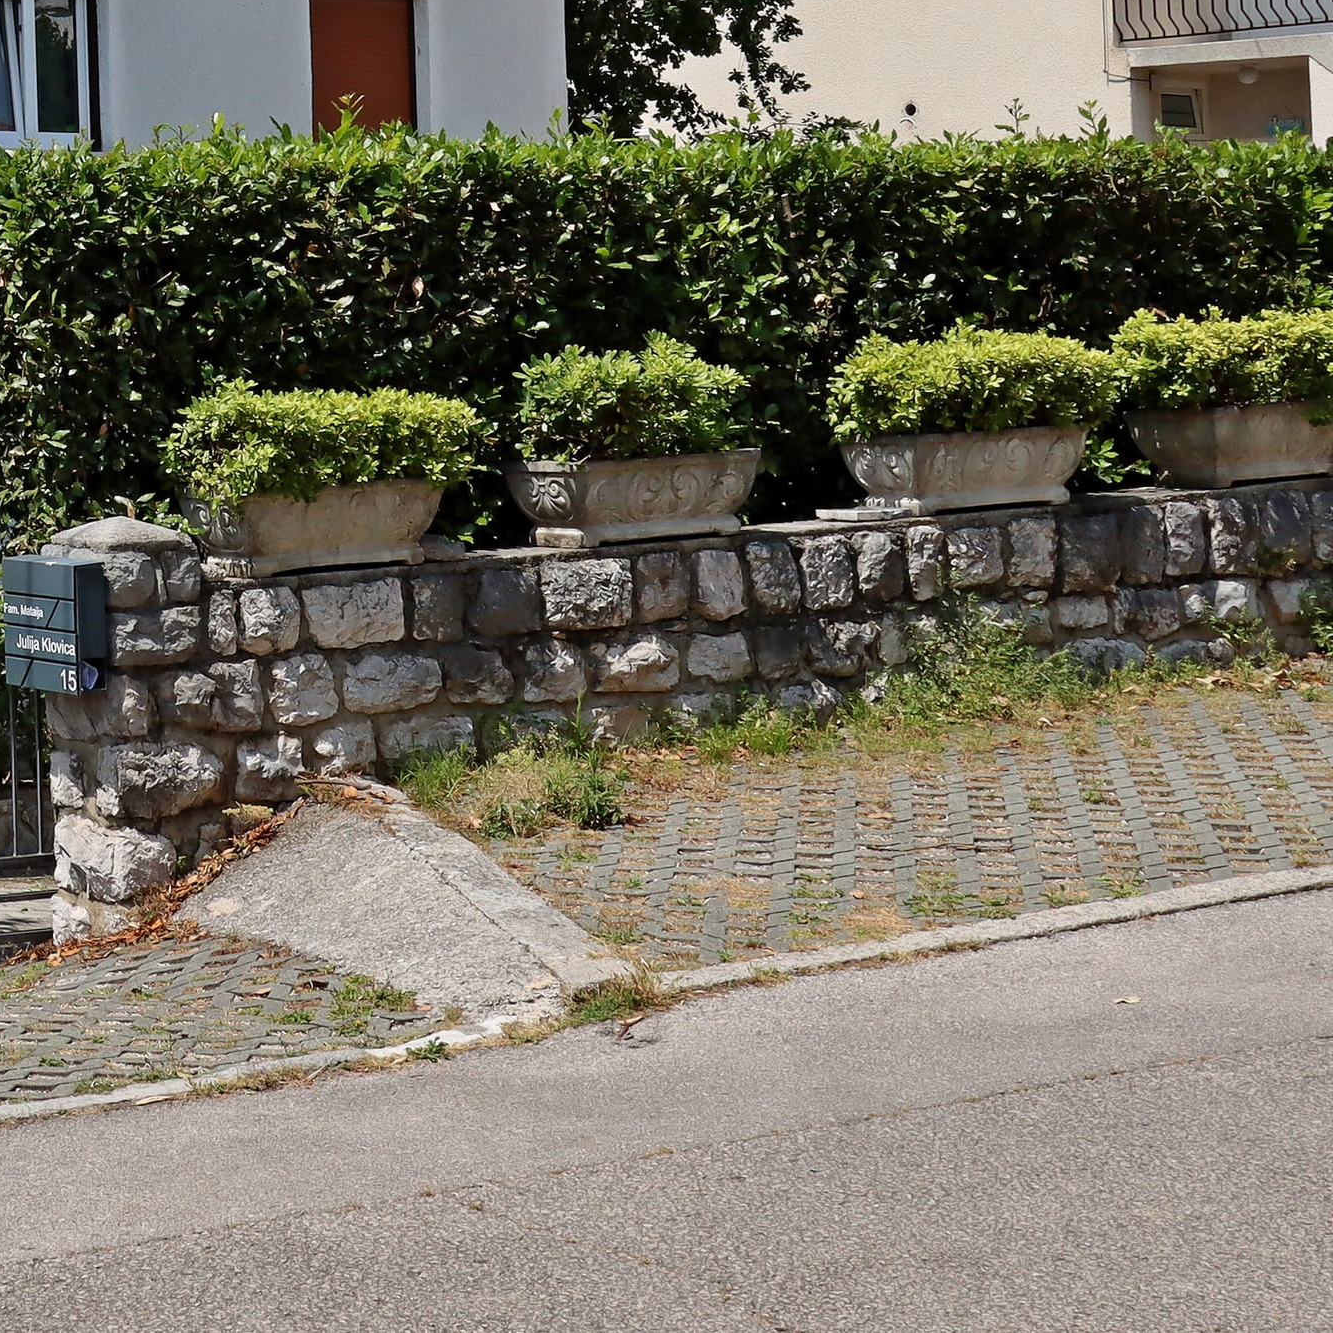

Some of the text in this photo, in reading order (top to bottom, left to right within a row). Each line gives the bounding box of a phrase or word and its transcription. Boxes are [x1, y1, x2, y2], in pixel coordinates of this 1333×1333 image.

[3, 602, 19, 615] Fam.
[16, 633, 76, 656] Julija Klovica
[60, 668, 77, 692] 15
